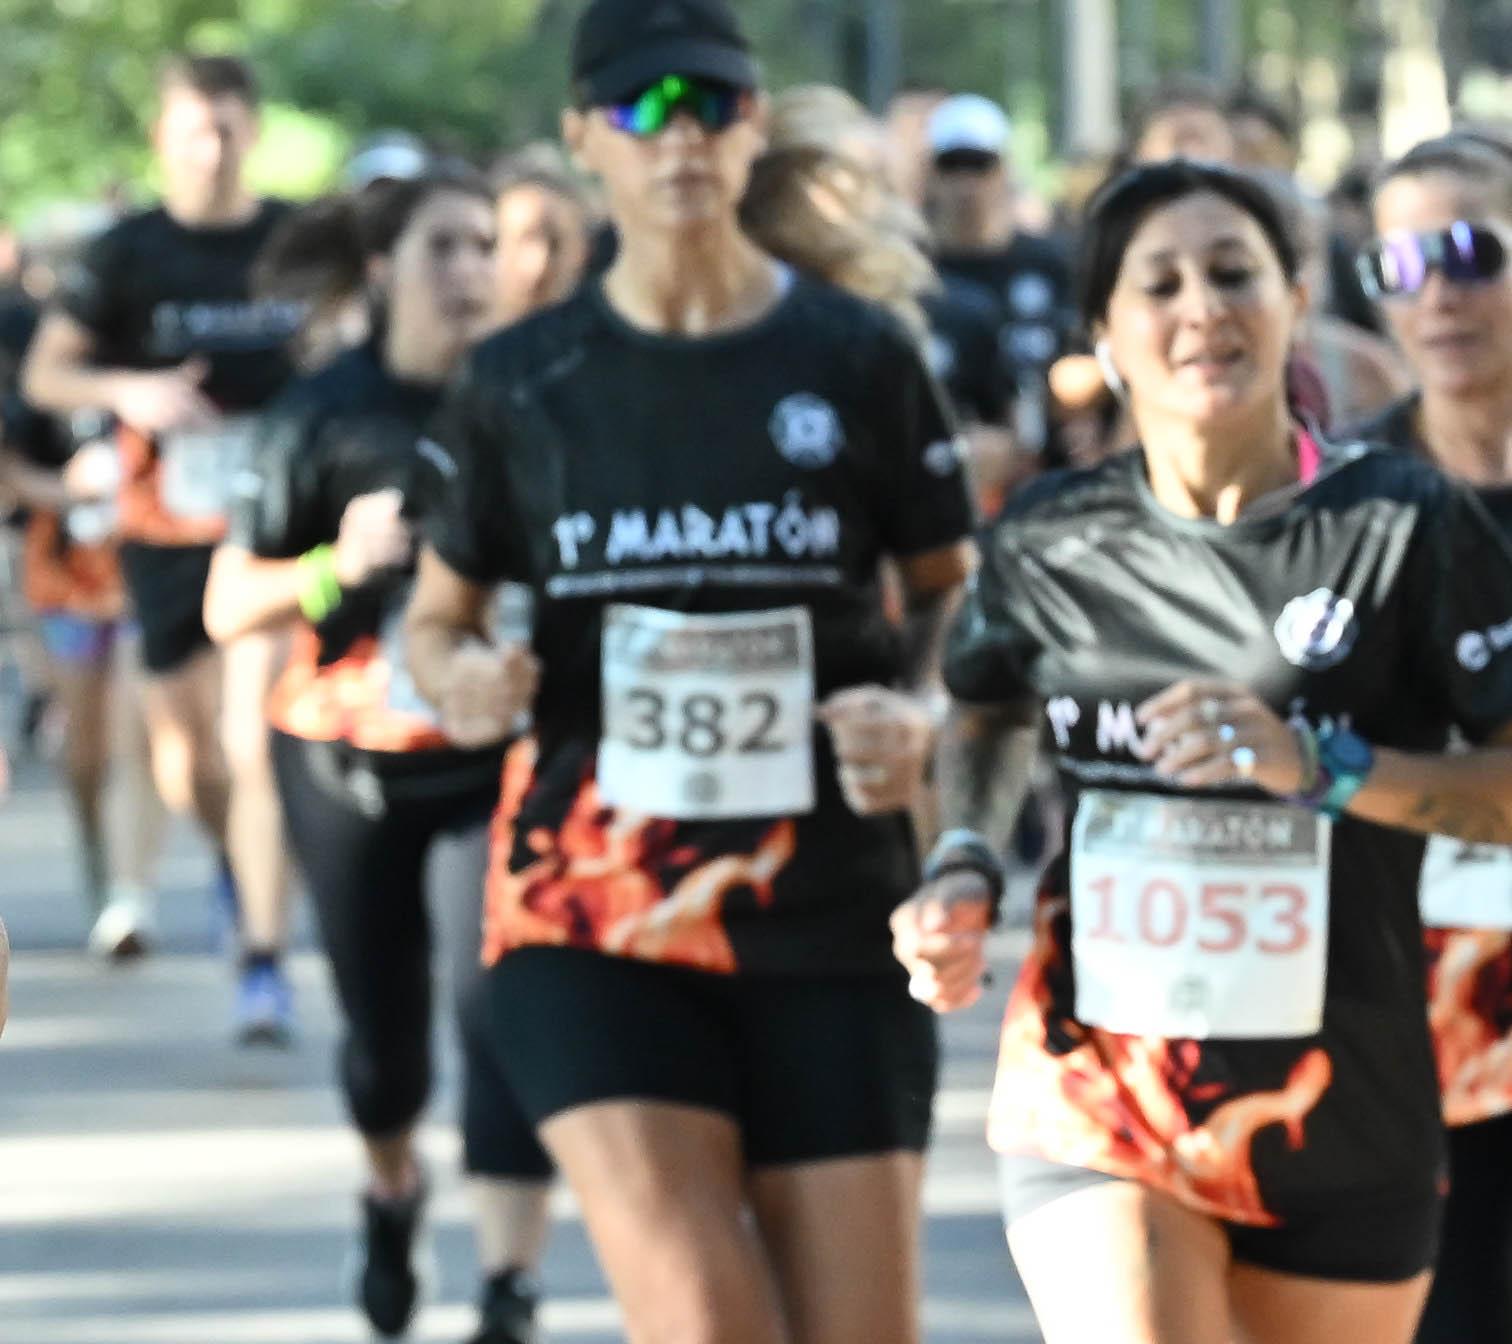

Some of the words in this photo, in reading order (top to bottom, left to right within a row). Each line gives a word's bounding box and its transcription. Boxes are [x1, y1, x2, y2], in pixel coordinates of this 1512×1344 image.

[605, 489, 840, 564] MARATÓN
[626, 687, 784, 757] 382
[1086, 875, 1312, 956] 1053
